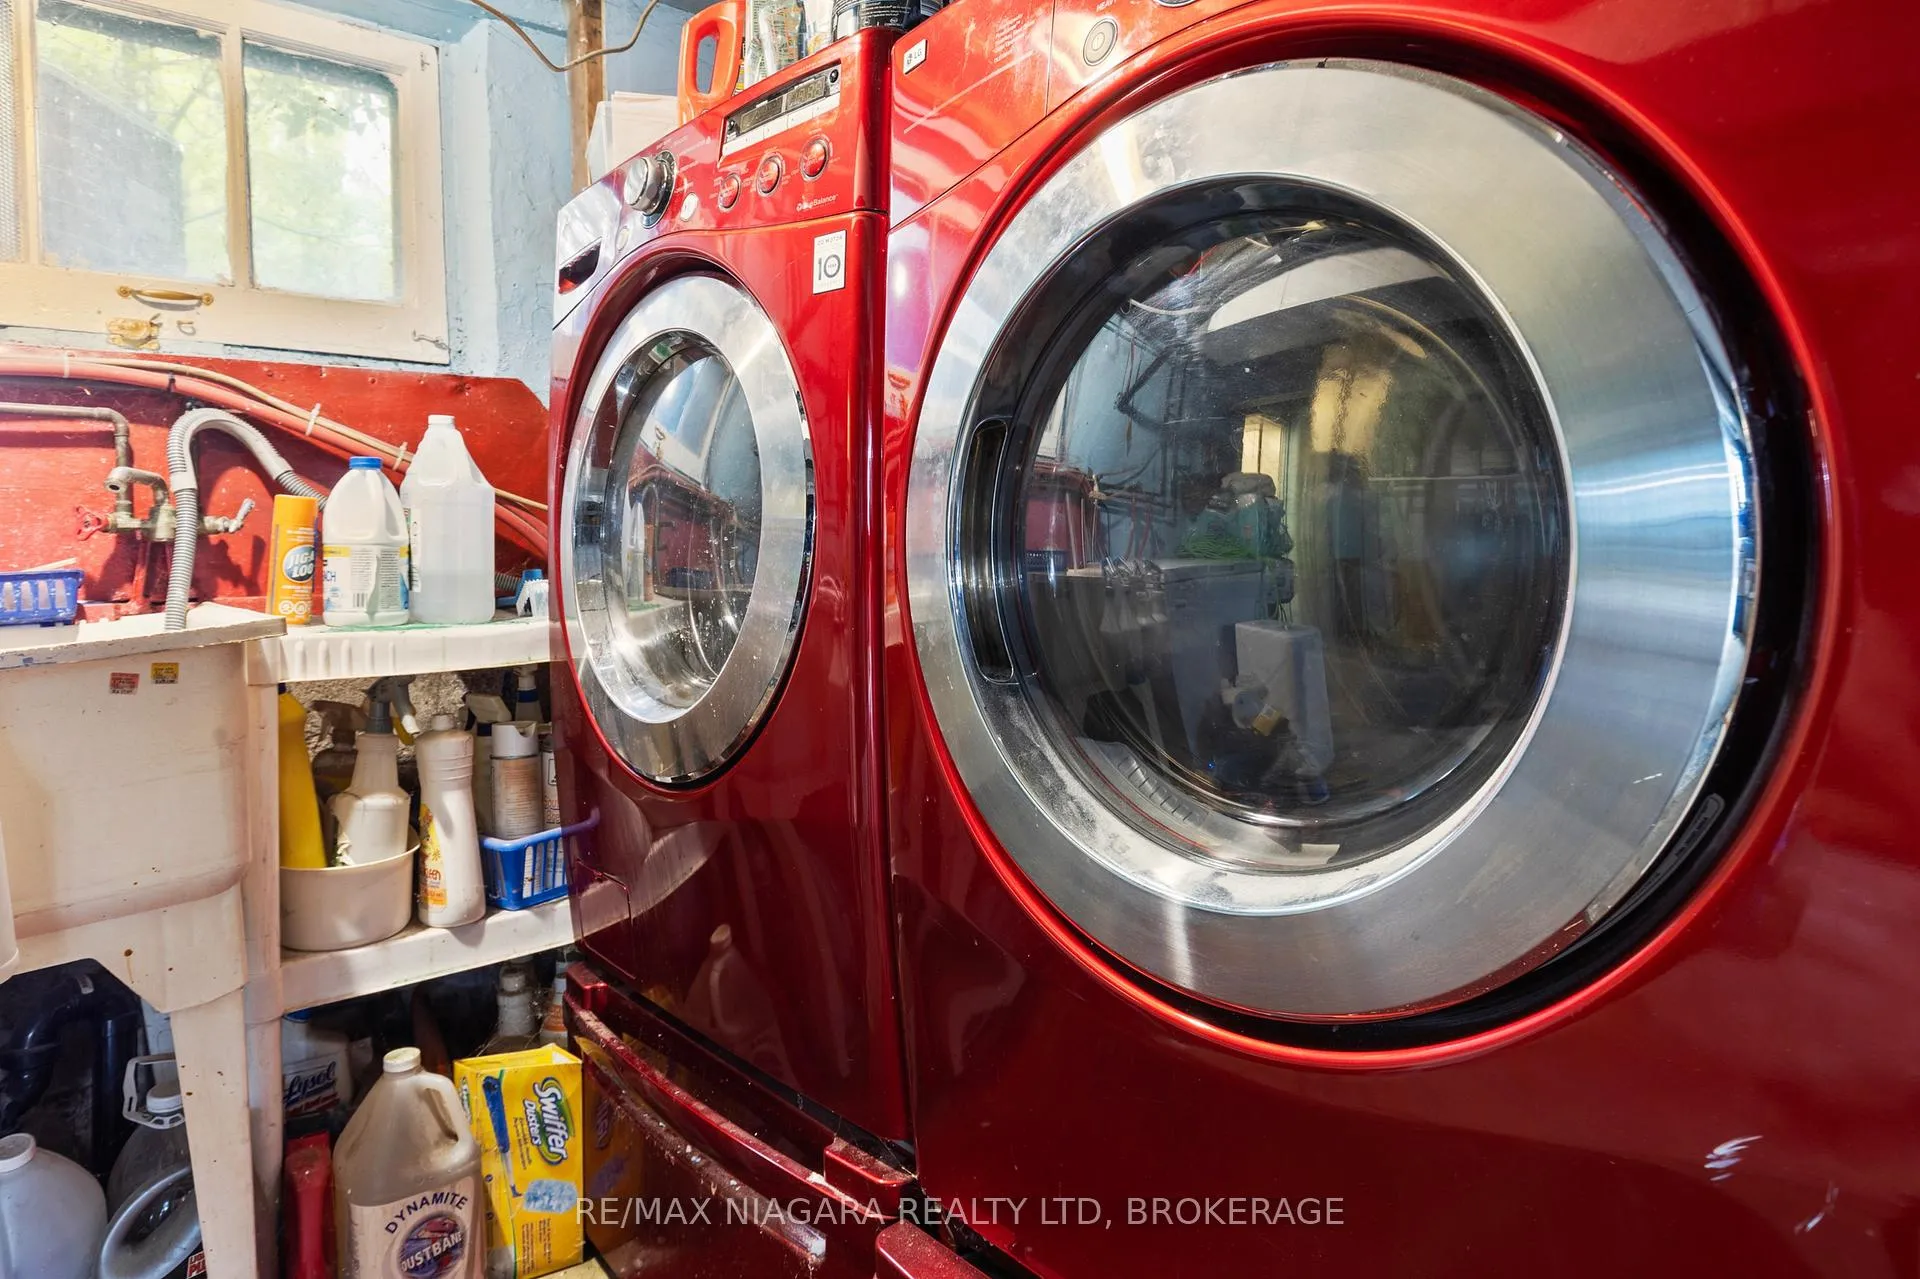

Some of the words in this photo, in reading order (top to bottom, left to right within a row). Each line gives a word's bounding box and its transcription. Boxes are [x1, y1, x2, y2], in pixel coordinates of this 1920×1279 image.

[283, 1060, 337, 1103] Lysol
[523, 1099, 542, 1147] Dusters
[533, 1082, 568, 1161] Swiffer
[384, 1191, 469, 1235] DYNAMITE
[400, 1231, 463, 1273] DUSTBANE
